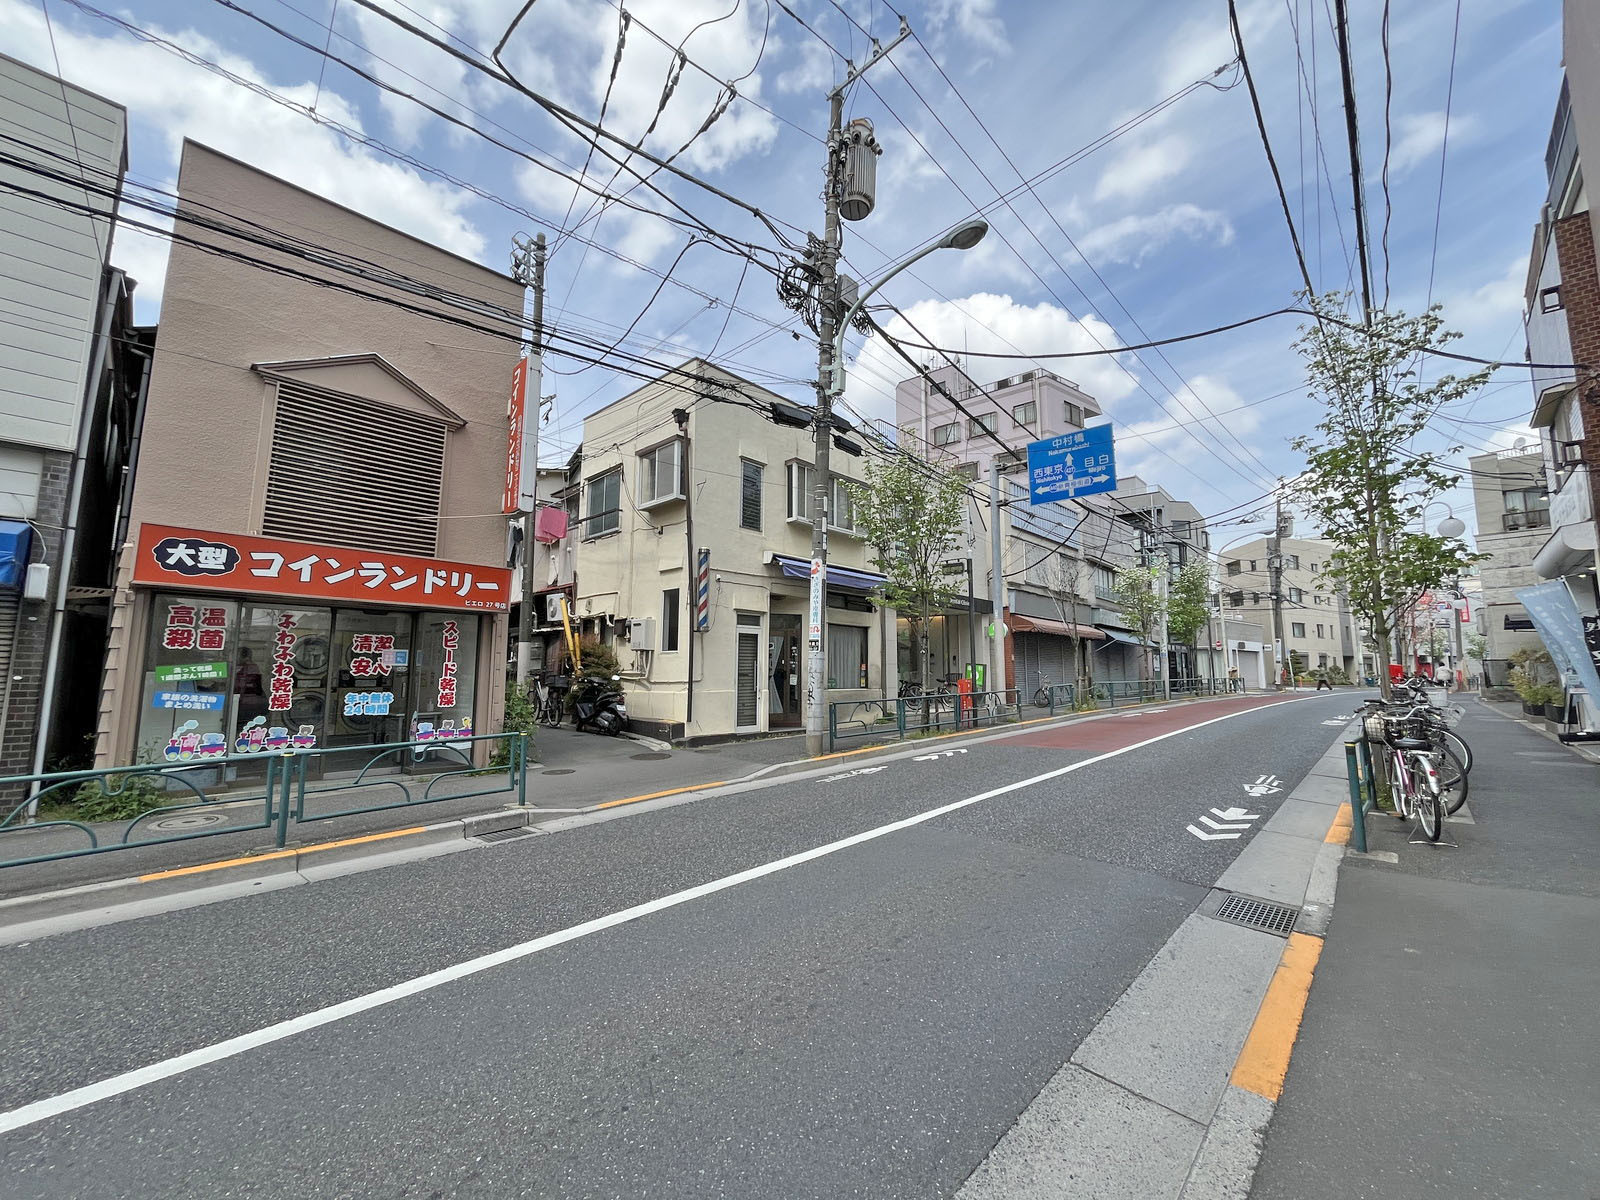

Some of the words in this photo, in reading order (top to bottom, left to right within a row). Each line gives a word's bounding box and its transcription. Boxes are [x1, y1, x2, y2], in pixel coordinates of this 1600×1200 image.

[506, 367, 521, 508] コインランドリー
[1052, 432, 1085, 449] 中村橋
[1033, 463, 1064, 479] 西東京
[1084, 454, 1109, 468] 目白
[165, 543, 228, 570] 大型
[249, 551, 500, 597] コインランドリー
[167, 604, 228, 628] 高温
[162, 626, 226, 651] 殺菌
[352, 633, 395, 653] 清潔
[268, 612, 298, 710] ふわふわ乾燥
[437, 619, 459, 707] スピード乾燥
[343, 704, 363, 716] 24
[363, 704, 390, 716] 時間
[344, 691, 395, 705] 年中無休
